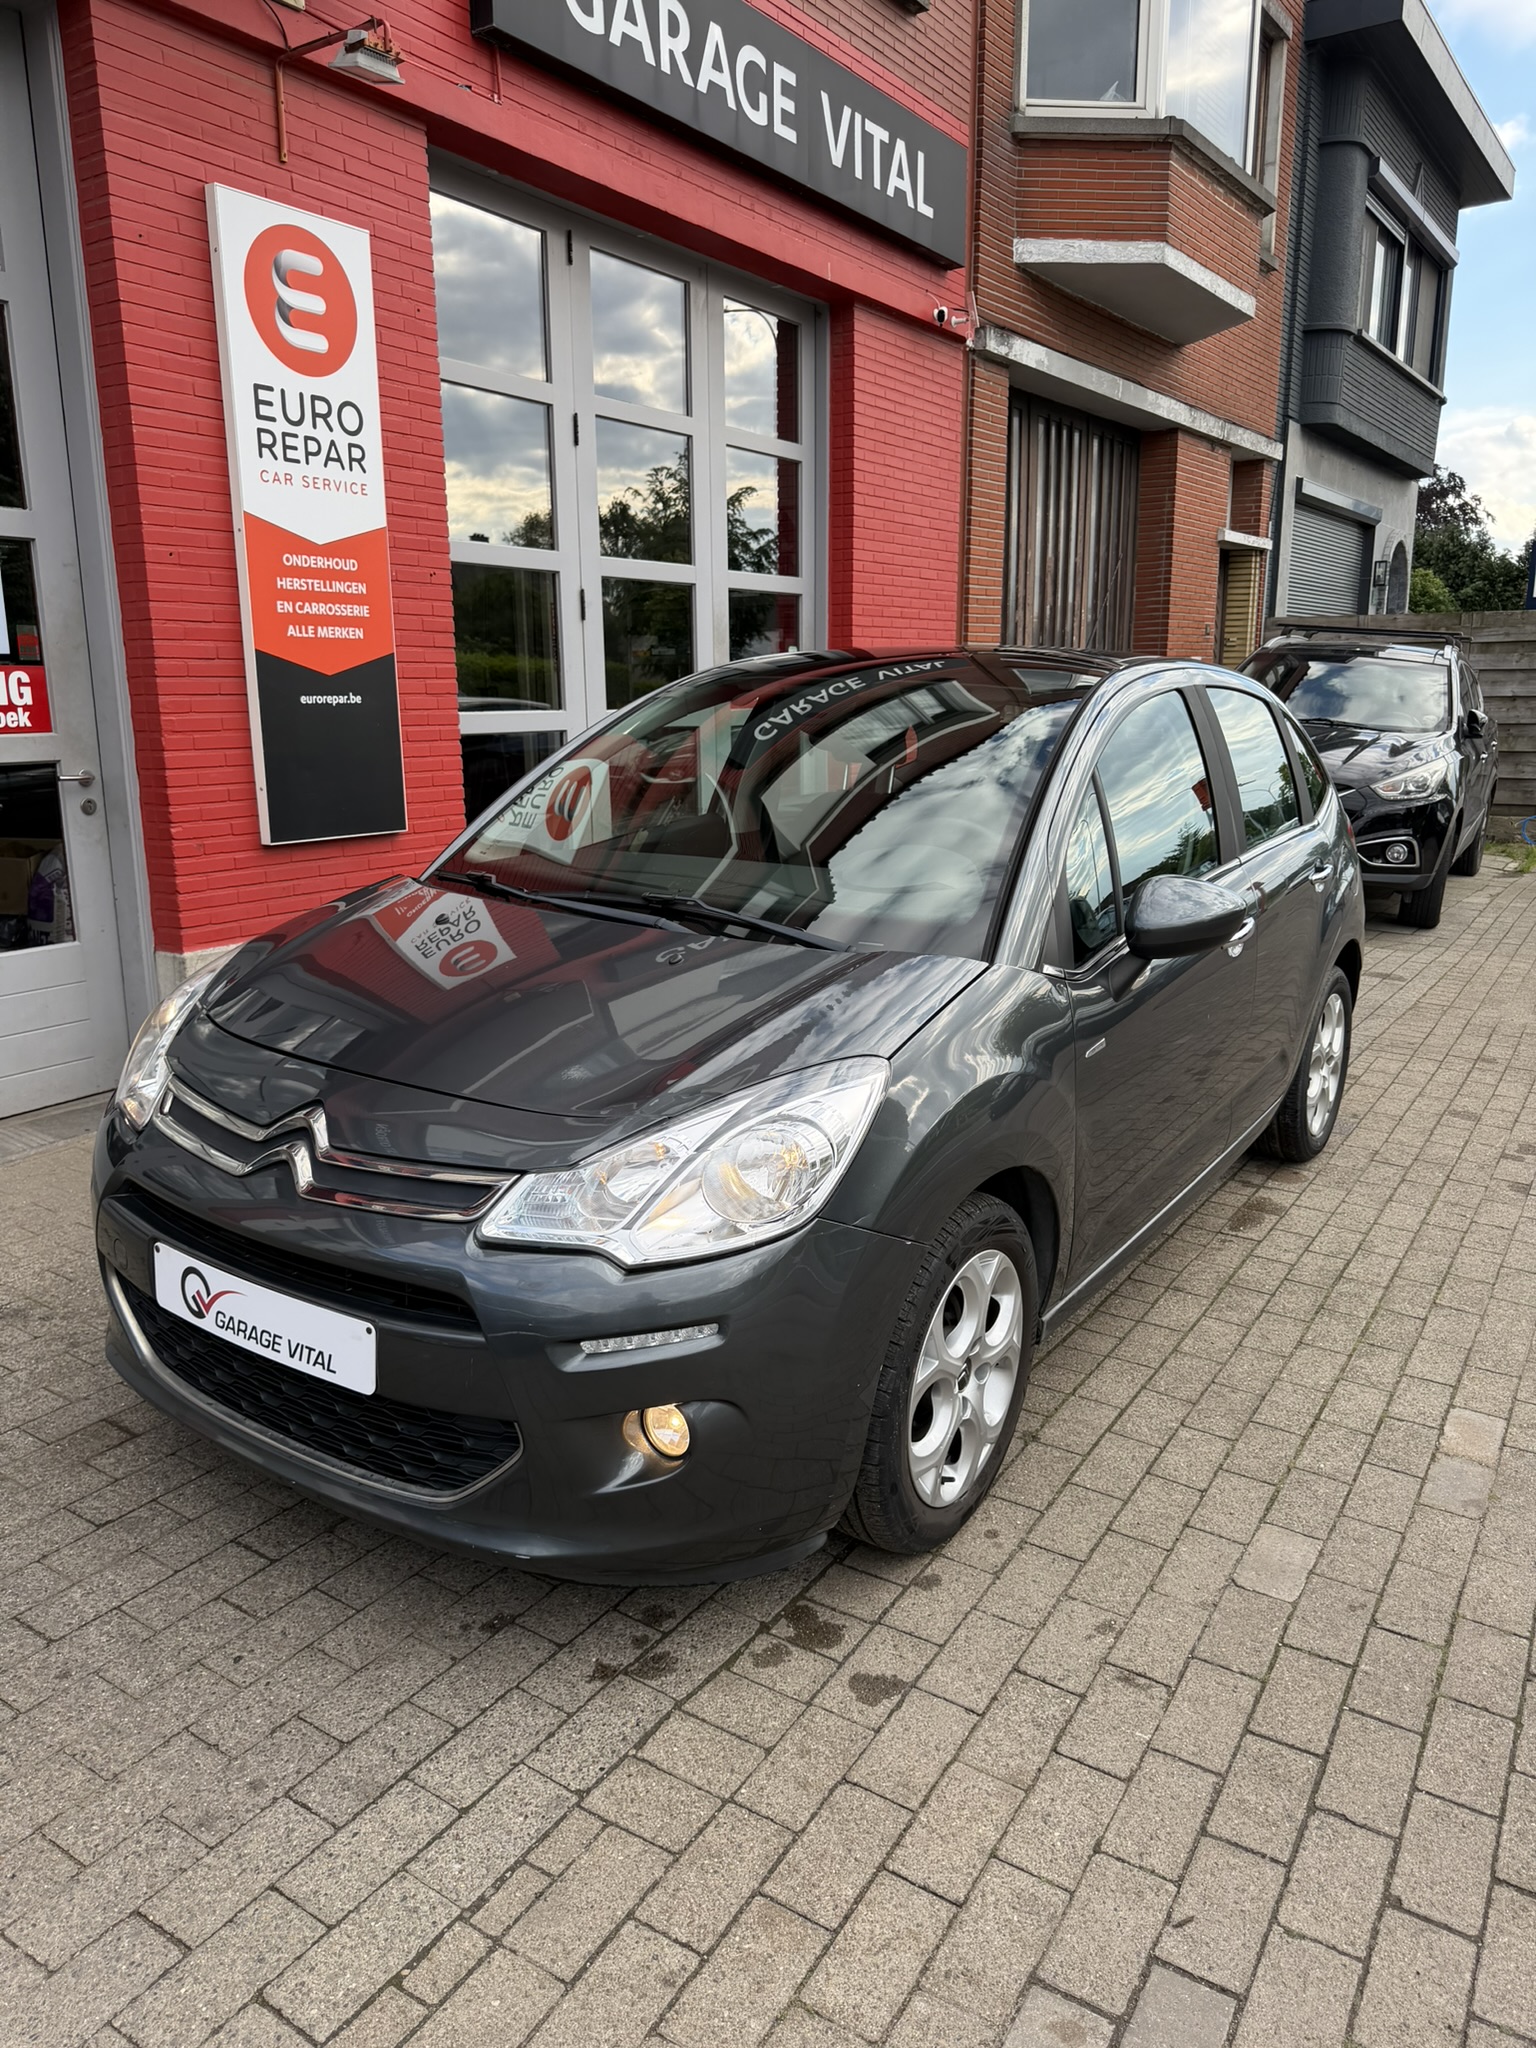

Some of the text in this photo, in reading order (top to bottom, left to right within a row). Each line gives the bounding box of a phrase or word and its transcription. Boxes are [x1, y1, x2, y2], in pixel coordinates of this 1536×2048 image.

[820, 90, 934, 219] VITAL
[253, 383, 364, 437] EURO
[256, 427, 367, 474] REPAR
[259, 469, 368, 496] CAR SERVICE
[282, 553, 358, 571] ONDERHOUD
[276, 577, 367, 595] HERSTELLINGEN
[276, 600, 370, 617] EN CARROSSERIE
[287, 624, 364, 639] ALLE MERKEN
[300, 692, 362, 706] eurorepar.be
[214, 1310, 337, 1375] GARAGE VITAL
